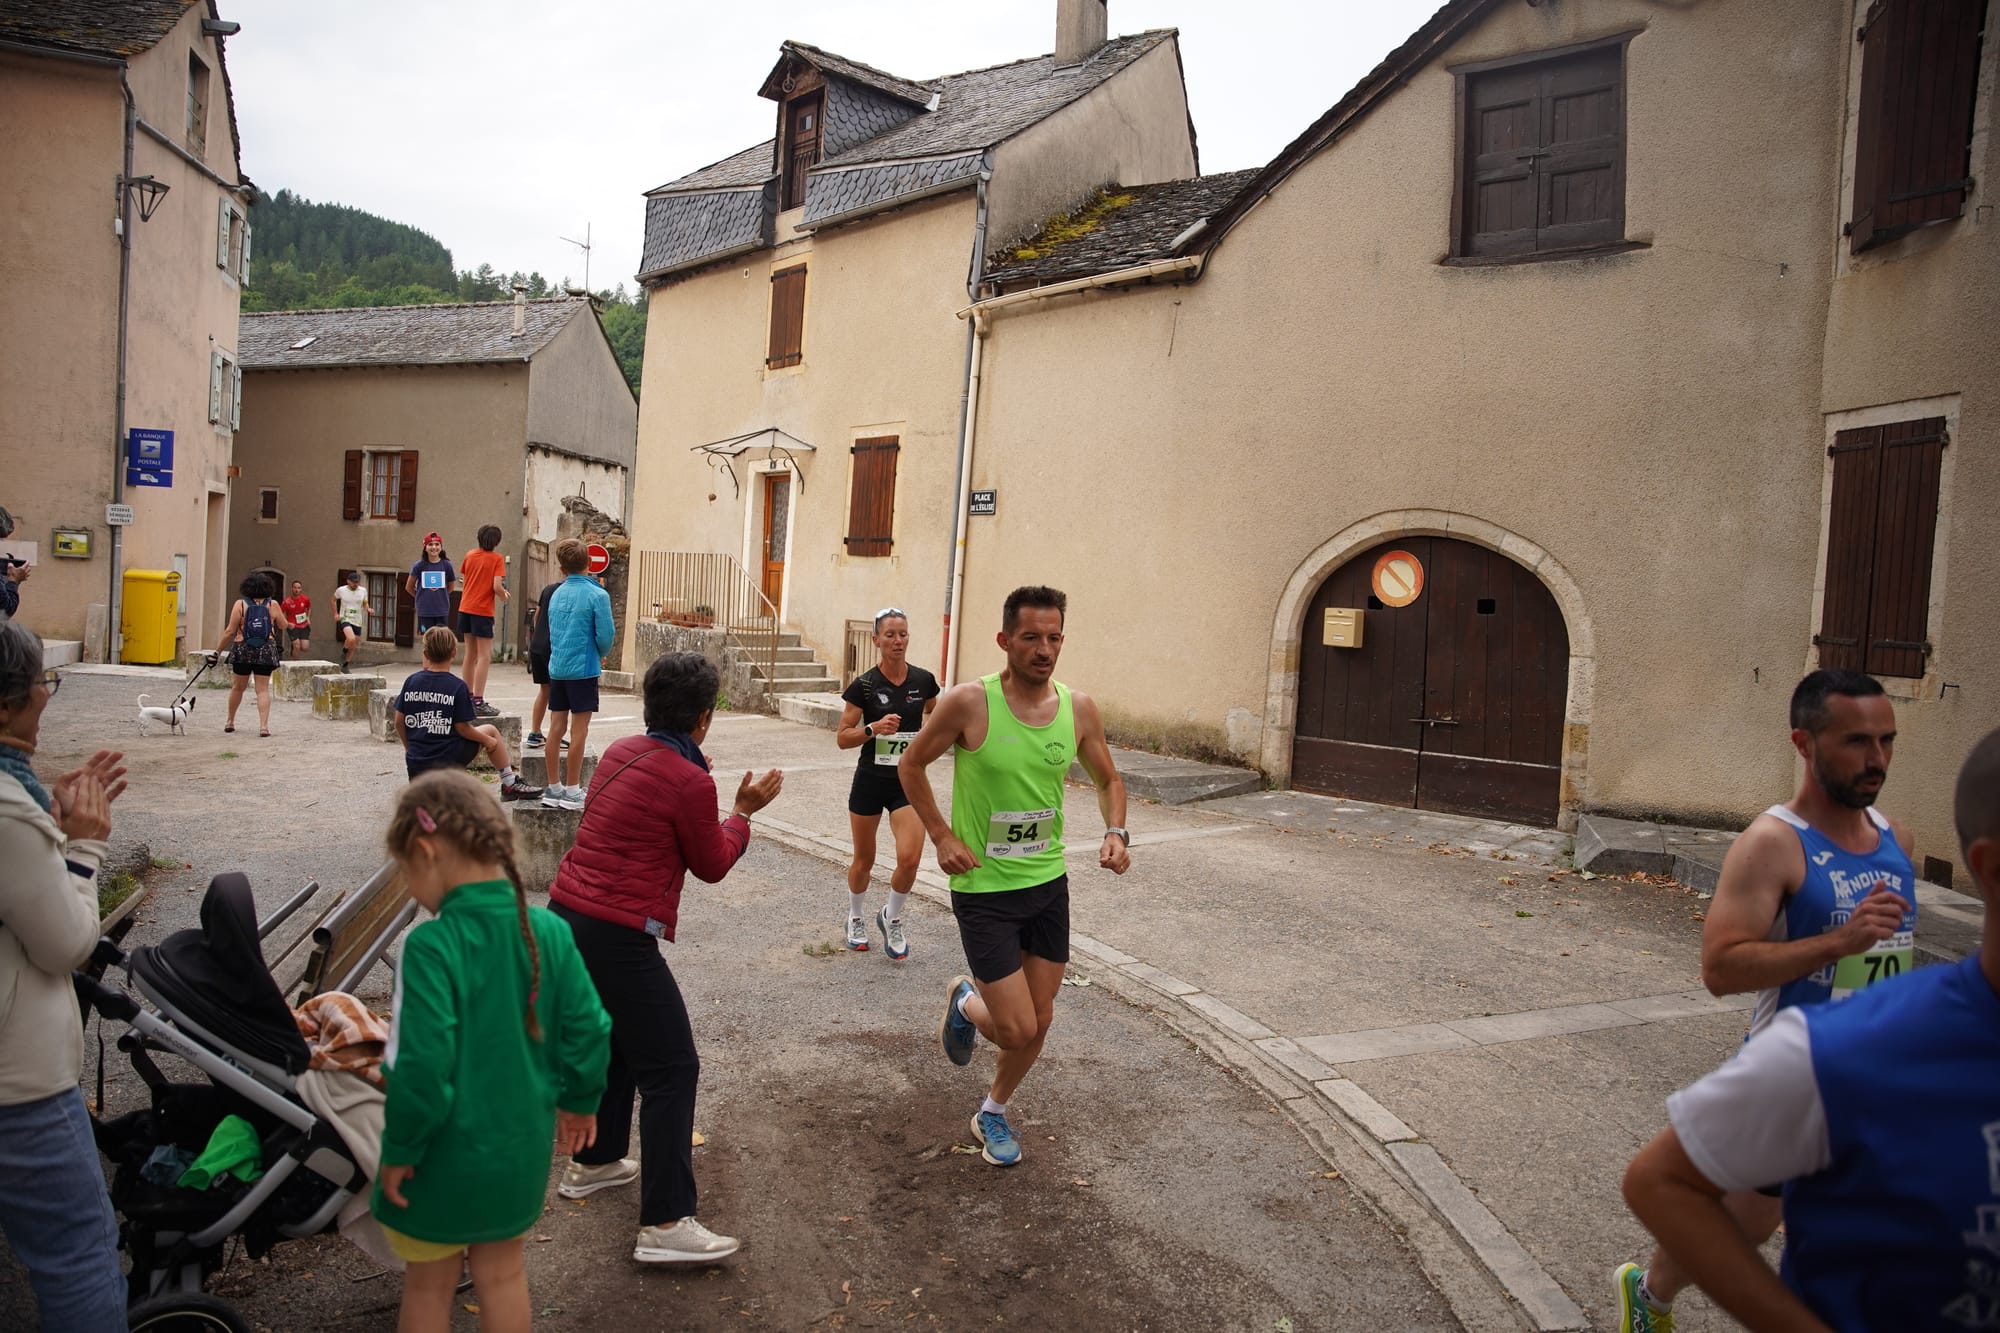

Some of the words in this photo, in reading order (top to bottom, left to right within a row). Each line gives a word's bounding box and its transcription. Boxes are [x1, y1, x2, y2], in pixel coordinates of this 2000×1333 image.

[974, 493, 991, 501] PLACE
[404, 691, 455, 706] ORGANISATION
[1006, 822, 1038, 843] 54
[1632, 1306, 1645, 1333] HO
